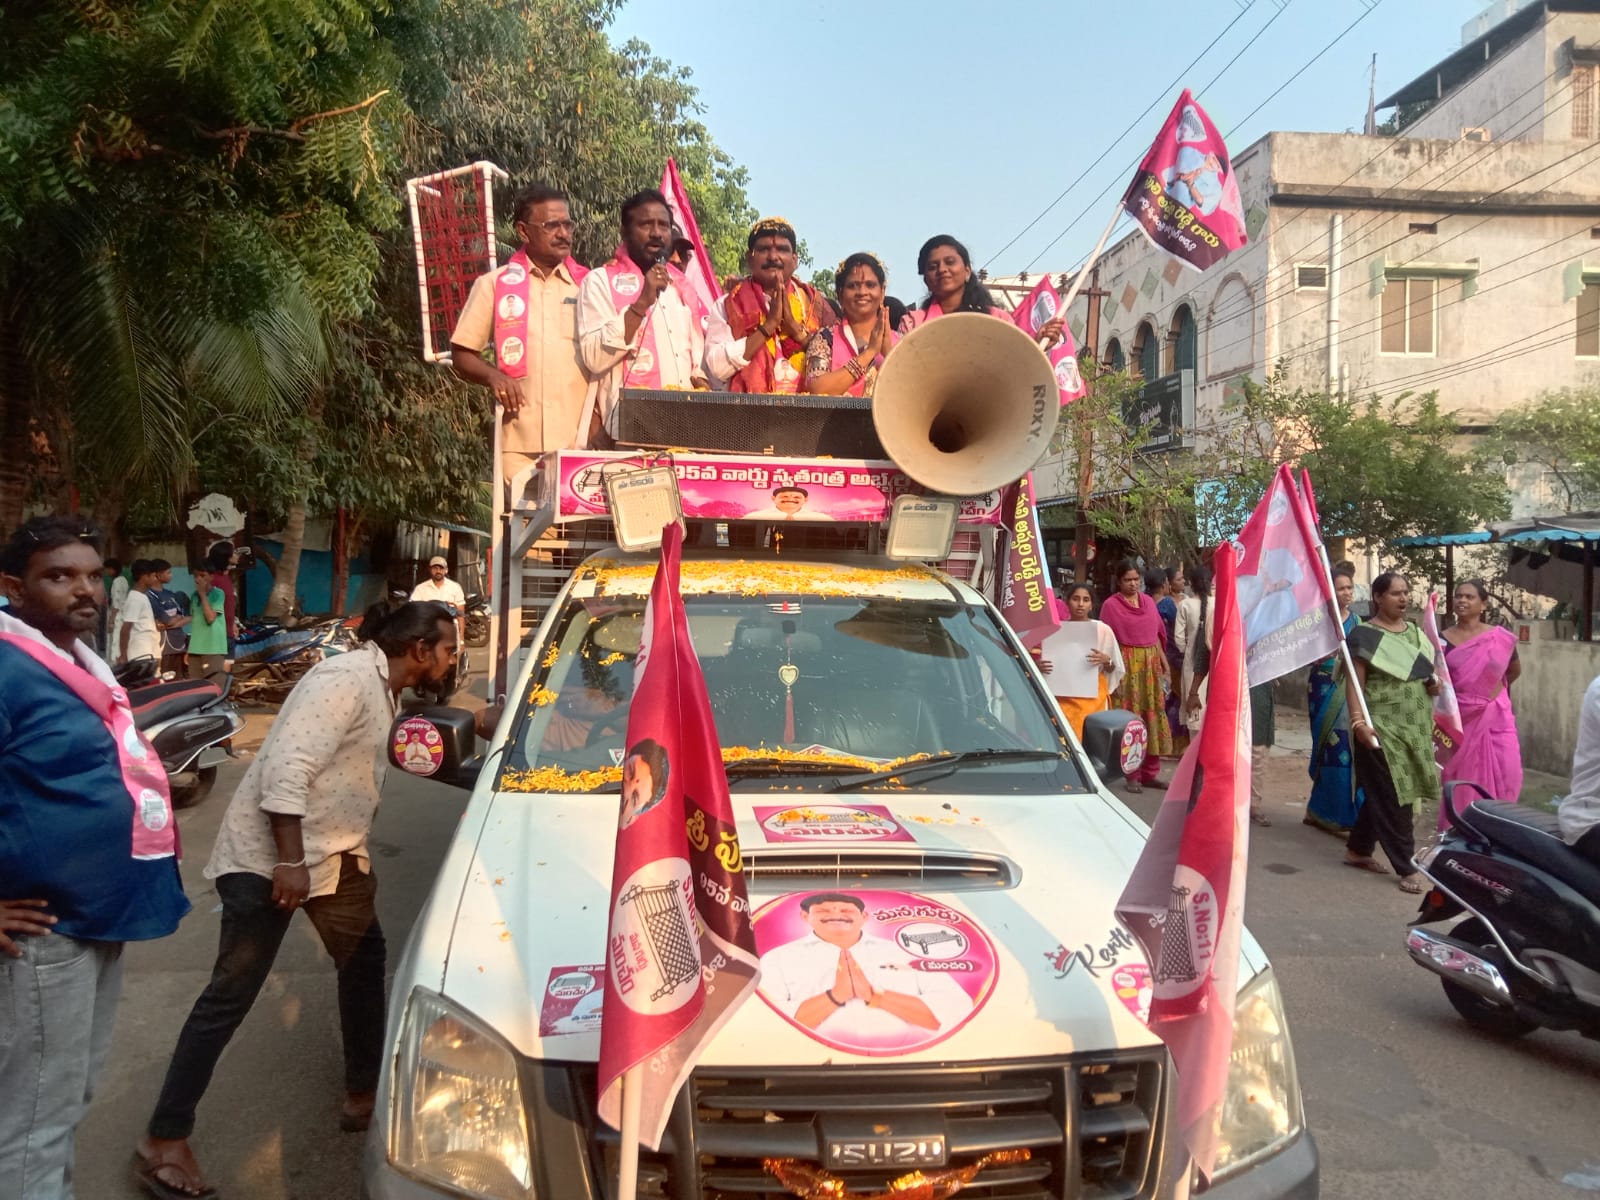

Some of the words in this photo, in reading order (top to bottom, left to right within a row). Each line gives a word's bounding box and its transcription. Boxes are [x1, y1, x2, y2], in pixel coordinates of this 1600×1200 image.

[1031, 384, 1047, 439] ROXY
[676, 465, 718, 481] 95వ
[721, 467, 769, 489] వార్డు
[772, 468, 846, 488] స్వతంత్ర
[1014, 555, 1042, 582] రెడ్డి
[1024, 581, 1046, 613] గారు
[686, 809, 710, 852] శ్రీ
[700, 872, 731, 906] 95వ
[1192, 891, 1212, 960] S.No:11
[612, 933, 634, 996] మంచం
[831, 1142, 944, 1164] ISUZU
